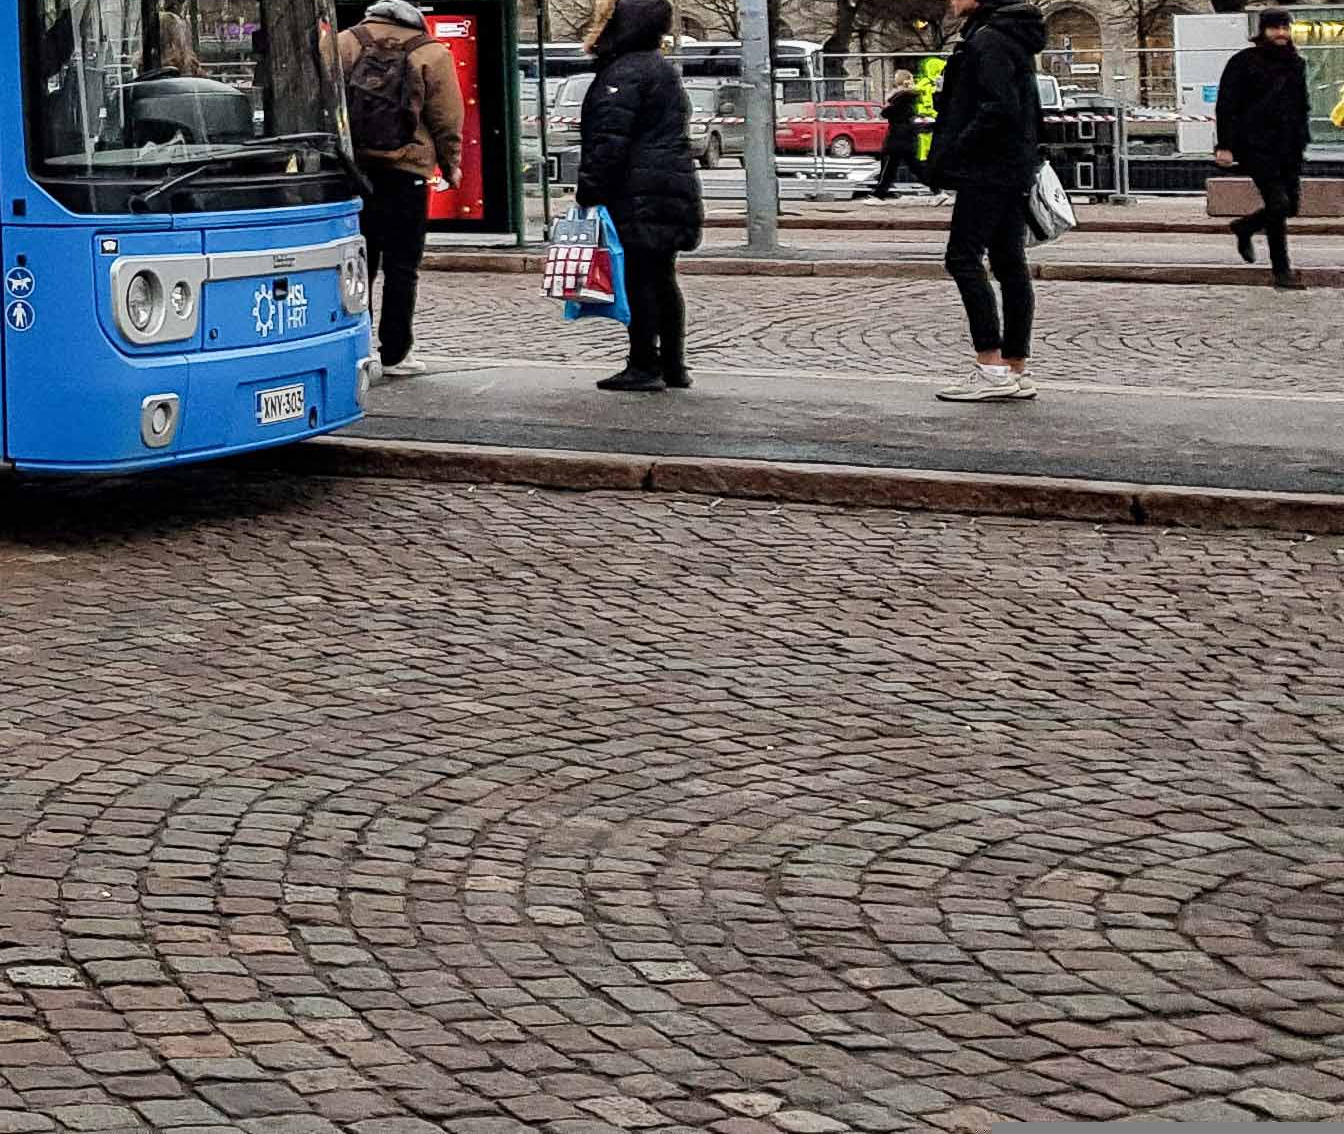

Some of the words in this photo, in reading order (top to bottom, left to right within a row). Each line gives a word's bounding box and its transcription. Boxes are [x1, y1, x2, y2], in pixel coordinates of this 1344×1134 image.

[287, 283, 308, 306] HSL
[287, 306, 308, 329] HRT
[264, 390, 304, 418] XNY-303
